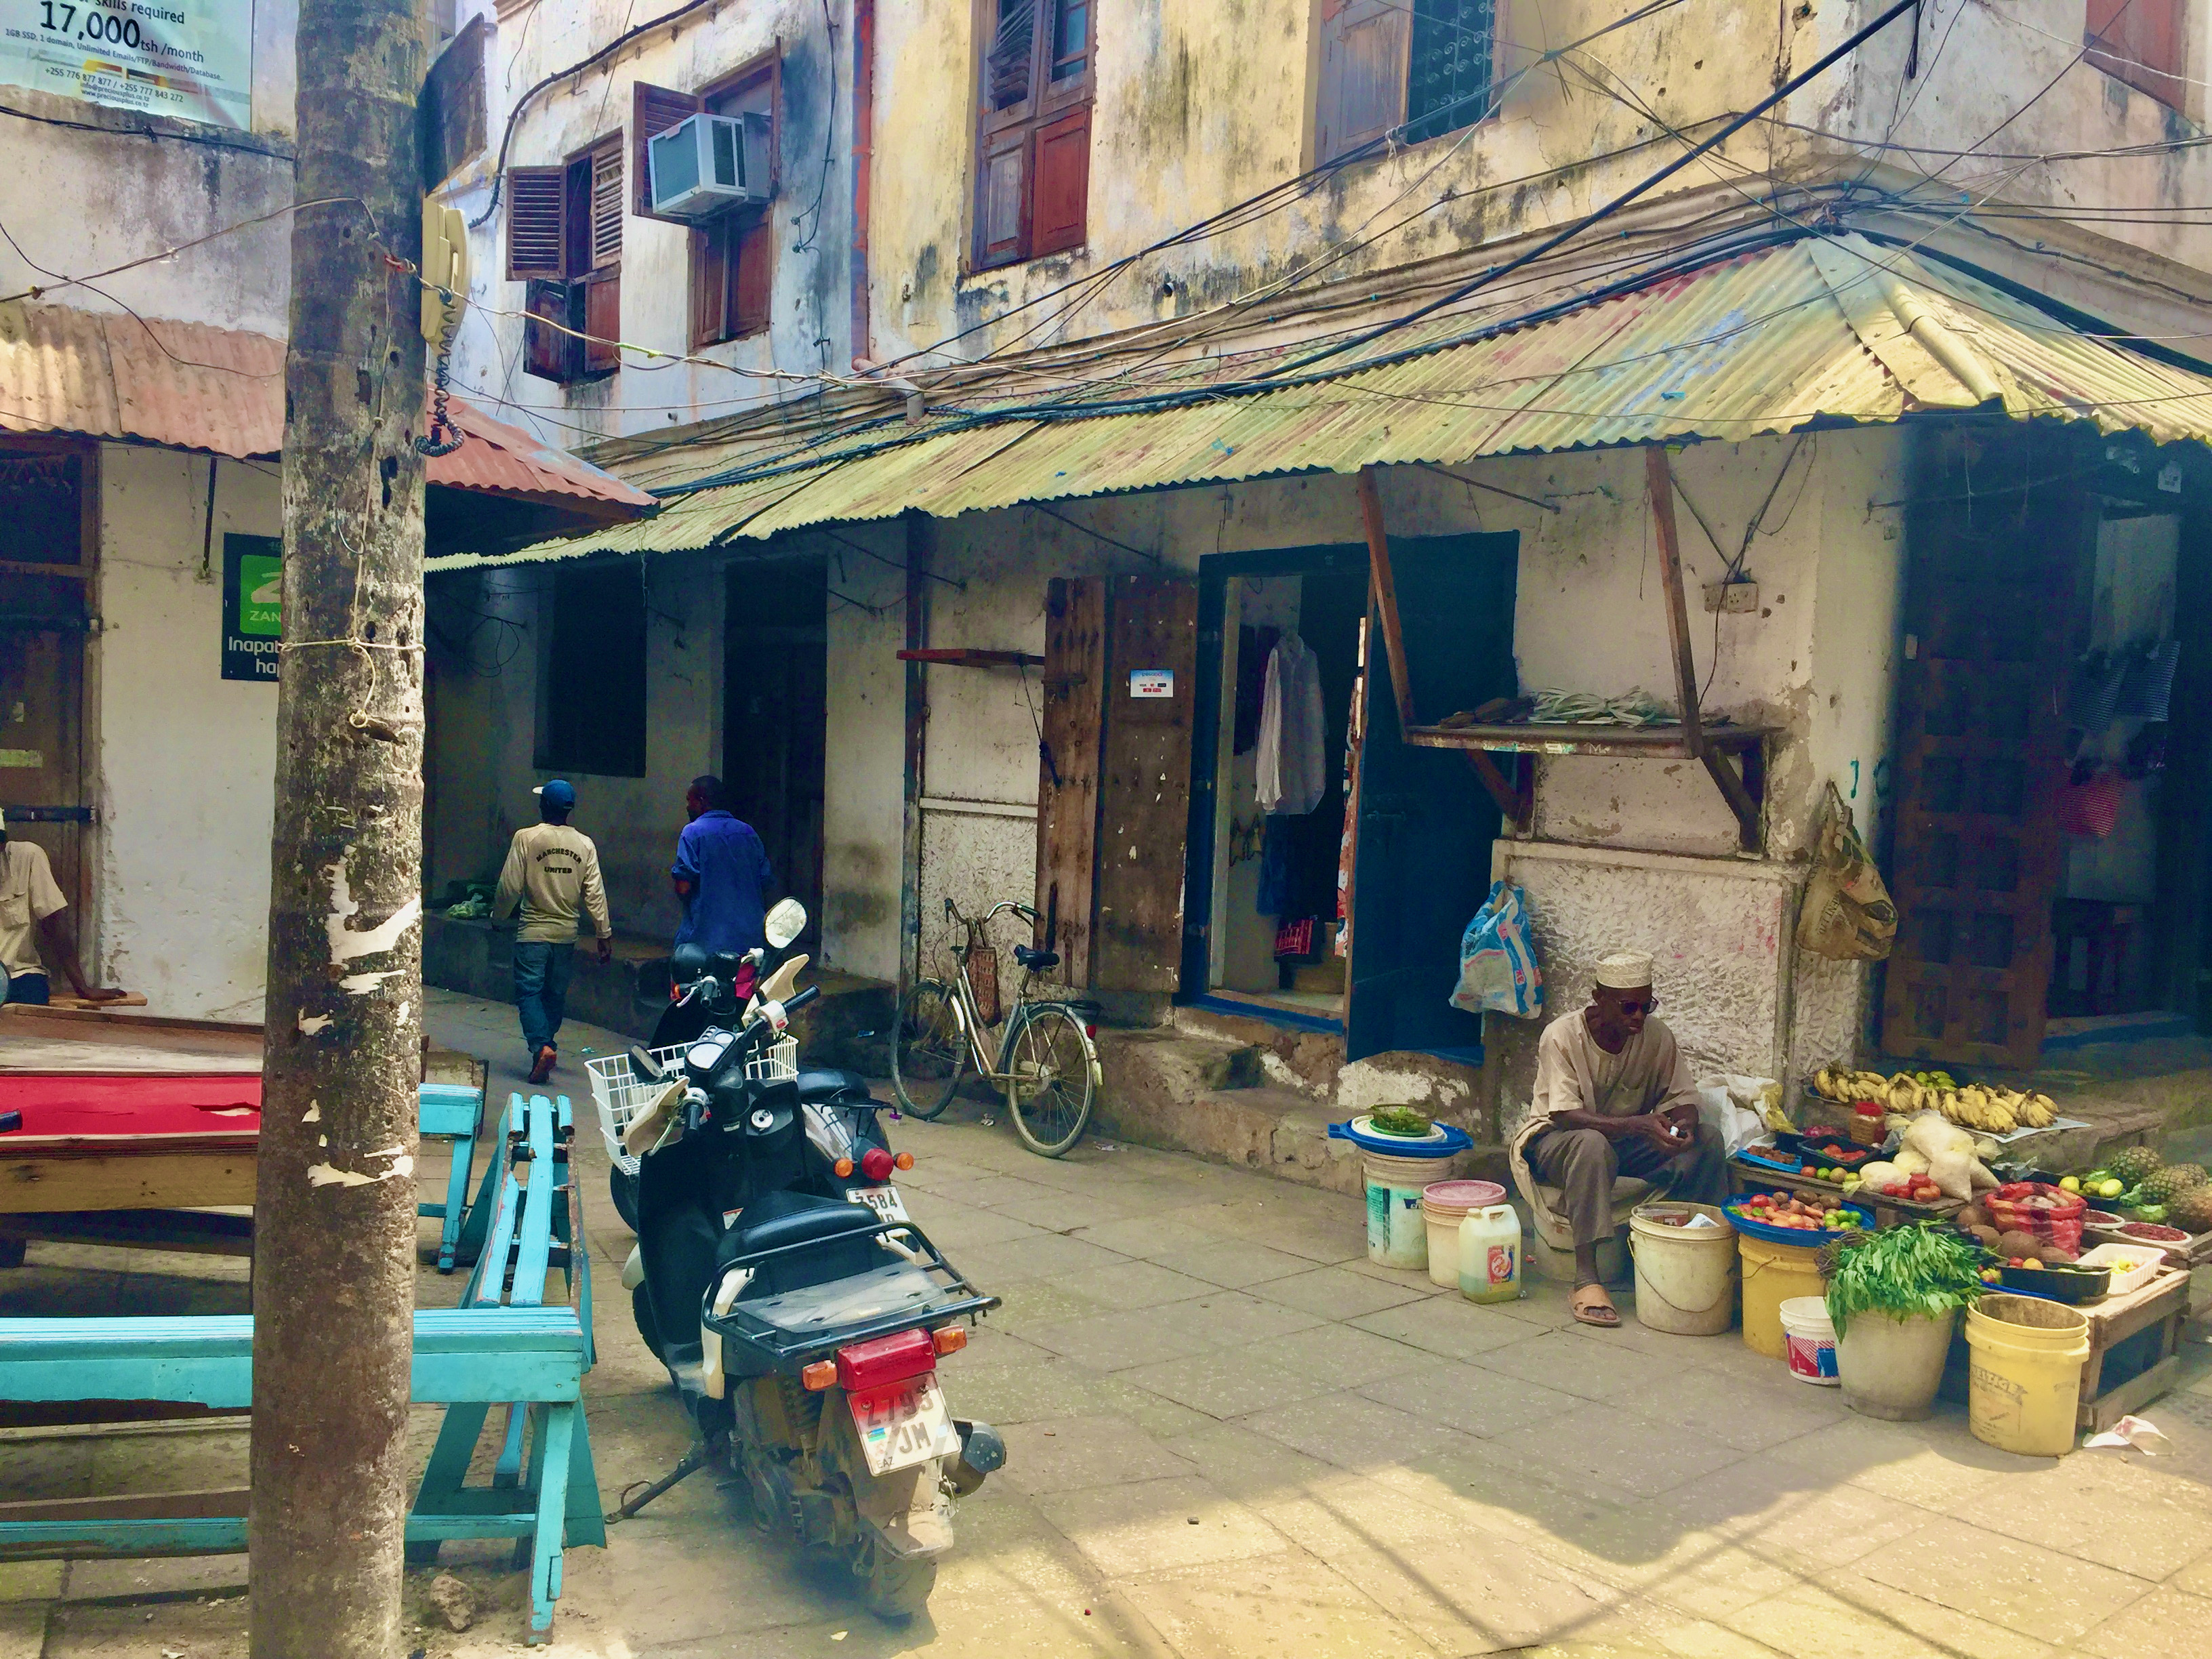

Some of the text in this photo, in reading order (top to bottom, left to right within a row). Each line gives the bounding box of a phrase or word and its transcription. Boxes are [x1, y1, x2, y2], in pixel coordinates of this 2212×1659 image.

[131, 2, 184, 24] required
[77, 42, 110, 56] Unlimited
[161, 43, 204, 62] /month
[45, 67, 64, 77] +255
[66, 70, 81, 80] 776
[82, 73, 96, 83] 877
[98, 77, 112, 86] 877
[120, 83, 138, 92] +255
[140, 86, 153, 96] 777
[155, 89, 168, 100] 843
[170, 93, 184, 102] 272
[536, 848, 581, 864] MANCHESTER
[899, 1422, 932, 1454] JM
[877, 1456, 895, 1469] EAZ
